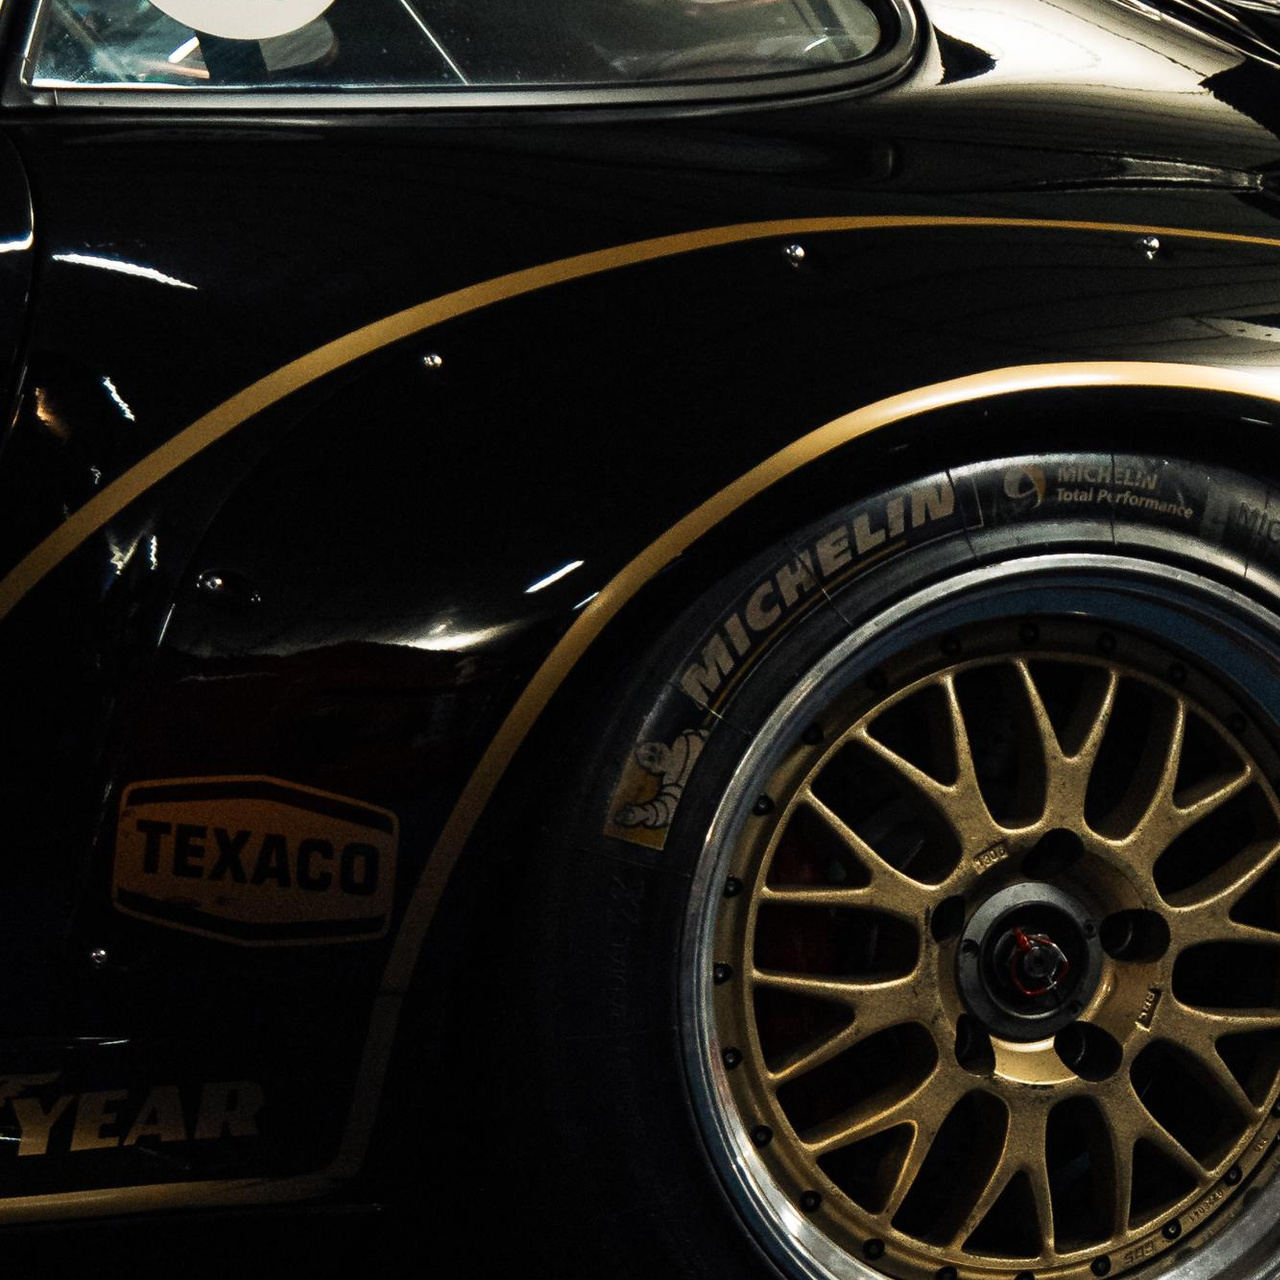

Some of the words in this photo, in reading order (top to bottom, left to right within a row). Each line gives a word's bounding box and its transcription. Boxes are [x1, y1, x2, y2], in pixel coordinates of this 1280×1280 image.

[1057, 465, 1158, 490] MICHELIN
[1057, 487, 1093, 502] Total
[1097, 489, 1194, 519] Performance
[680, 482, 956, 709] MICHELIN
[135, 820, 381, 897] TEXACO
[12, 1080, 266, 1157] YEAR
